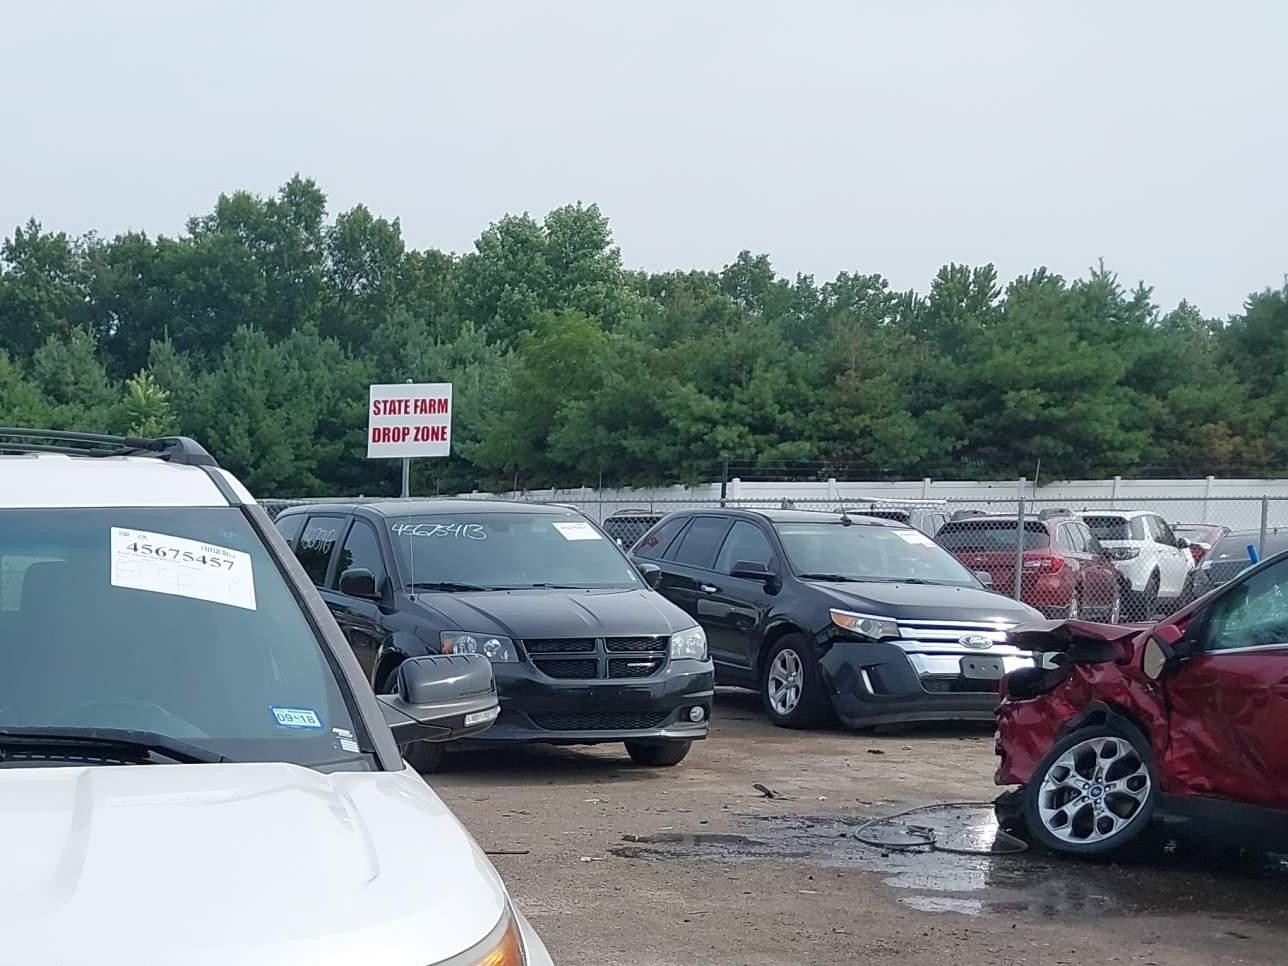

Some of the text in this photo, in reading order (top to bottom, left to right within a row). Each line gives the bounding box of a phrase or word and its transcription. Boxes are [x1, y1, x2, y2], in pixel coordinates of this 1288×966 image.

[372, 398, 449, 416] STATE FARM
[372, 425, 448, 443] DROP ZONE
[391, 523, 487, 540] 45675413
[126, 541, 235, 571] 45675457
